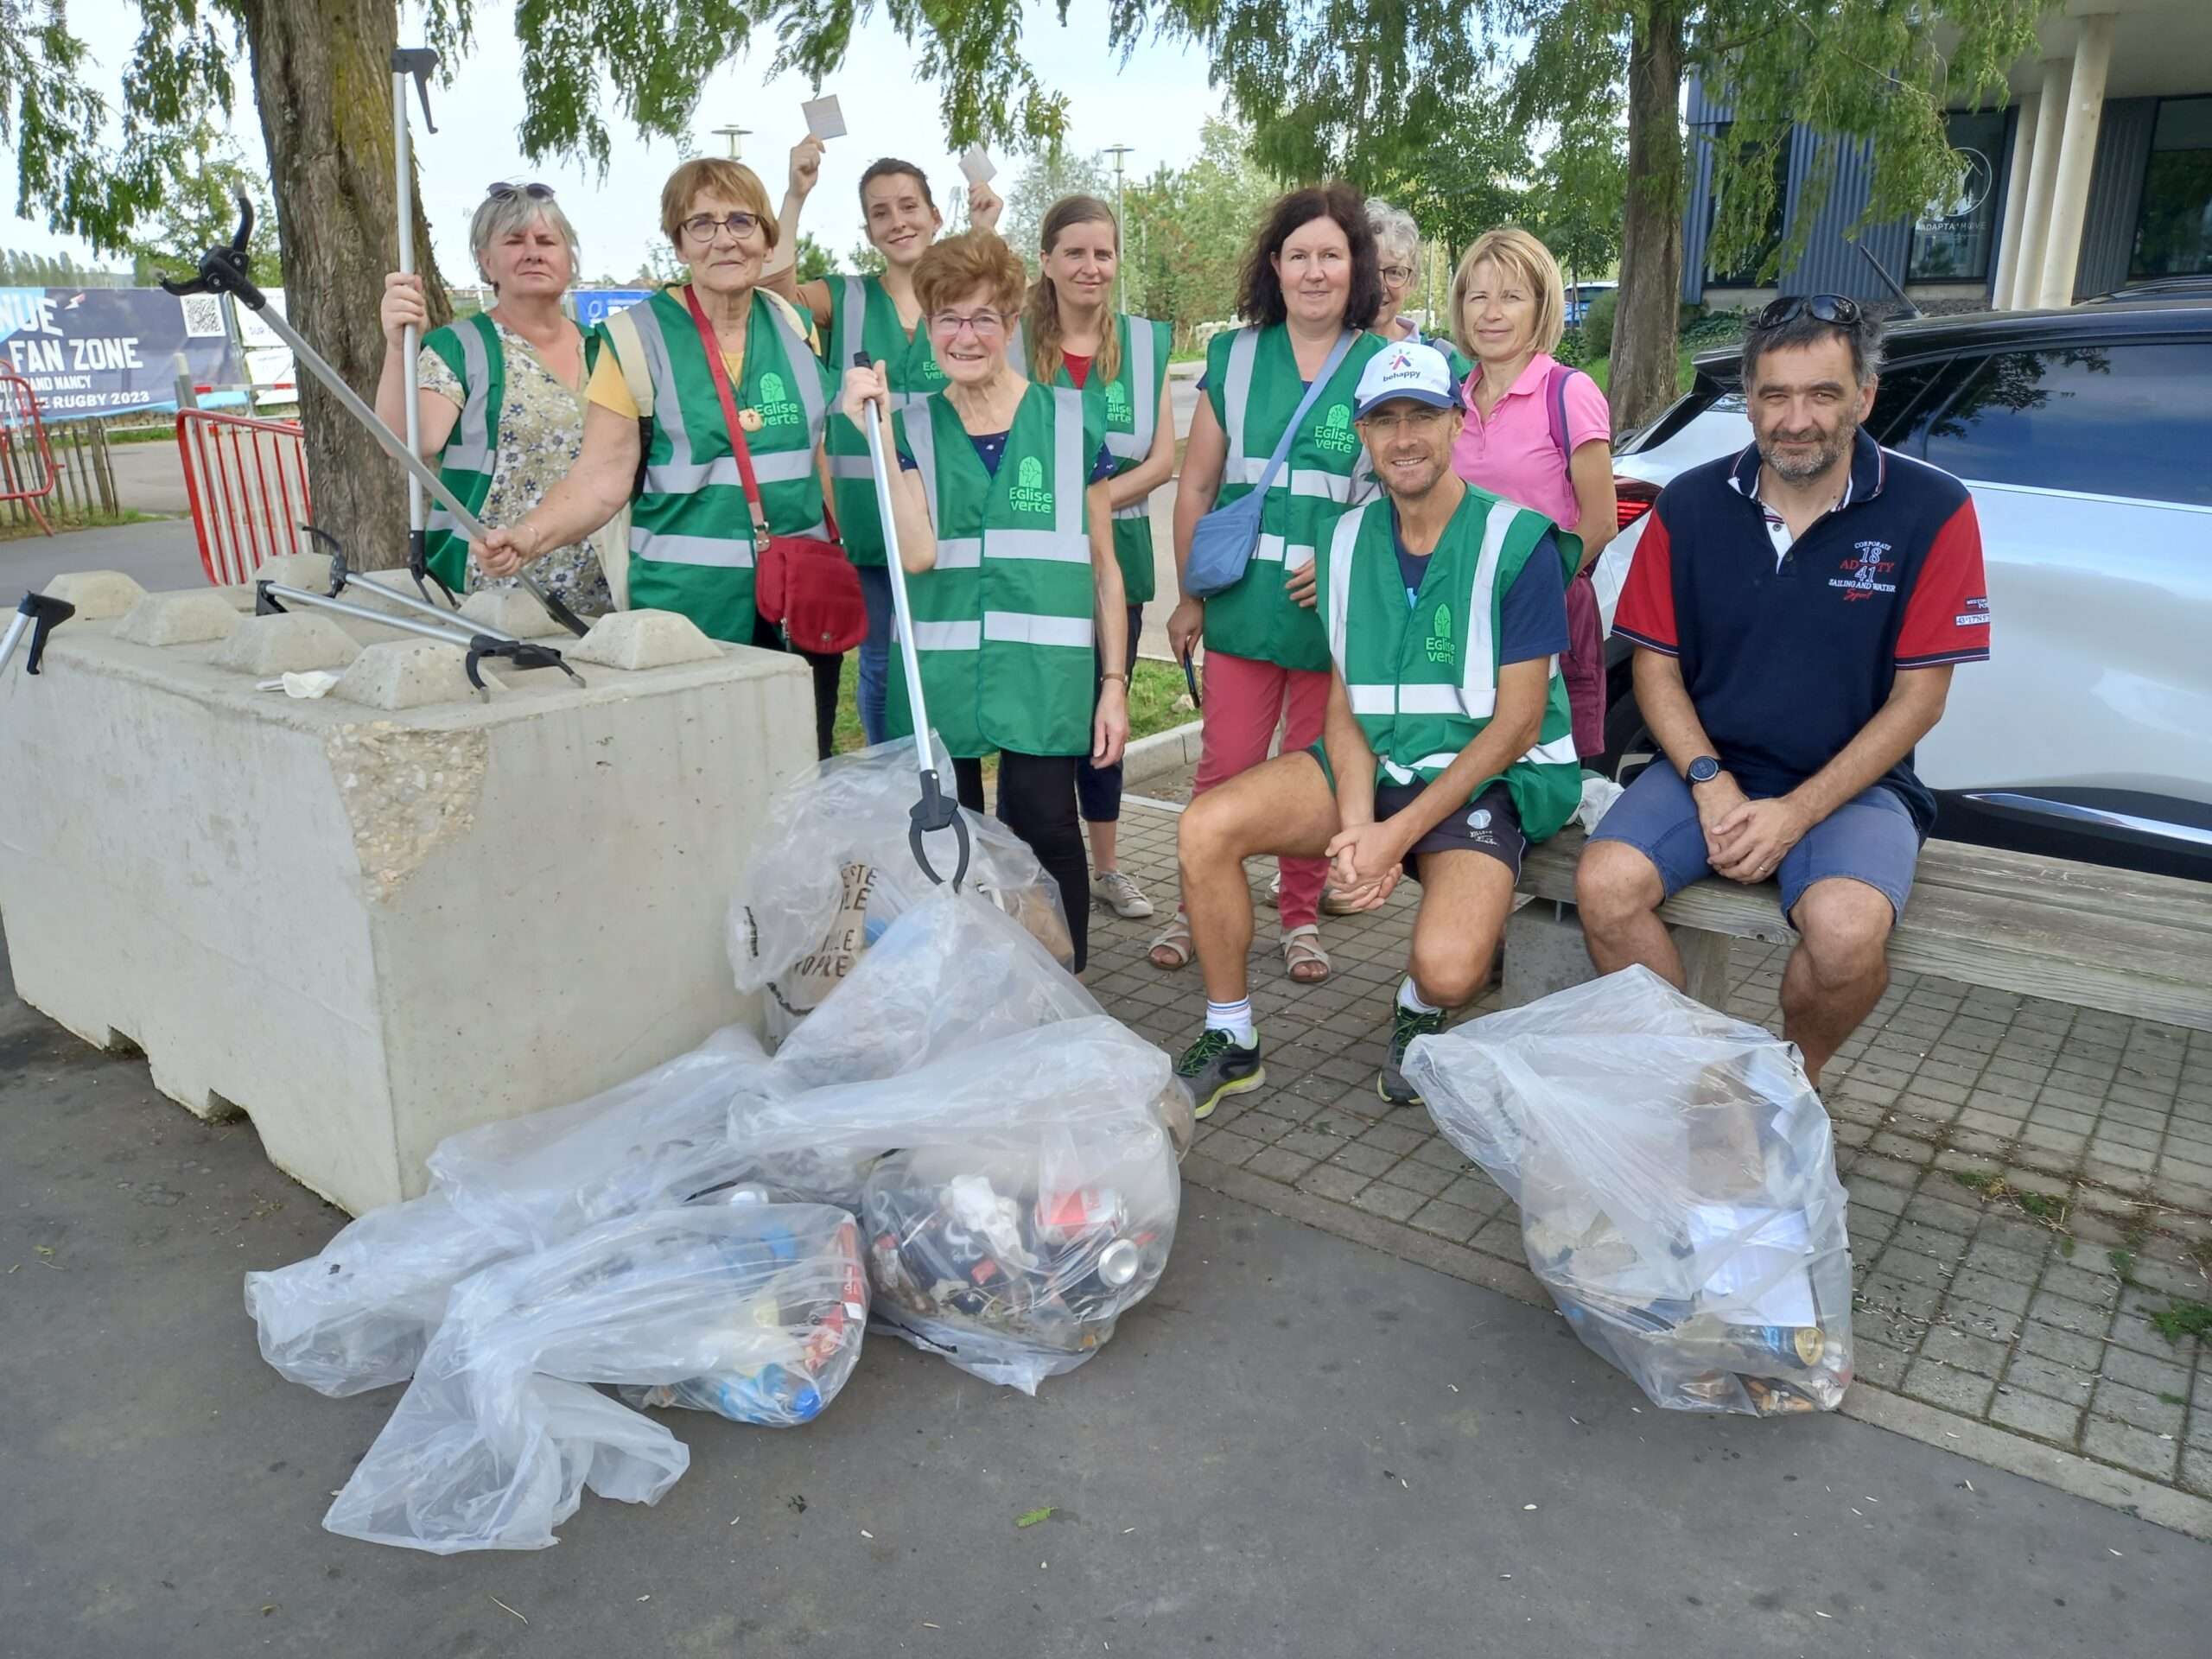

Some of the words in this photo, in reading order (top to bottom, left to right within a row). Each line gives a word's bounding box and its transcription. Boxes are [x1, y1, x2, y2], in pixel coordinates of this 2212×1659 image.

[8, 339, 66, 373] FAN
[68, 337, 144, 371] ZONE
[54, 374, 92, 388] NANCY
[1382, 371, 1421, 382] behappy
[53, 393, 106, 409] RUGBY
[110, 391, 149, 405] 2023
[1107, 413, 1131, 423] erte
[1315, 438, 1352, 454] verte
[1011, 500, 1052, 513] verte
[1859, 546, 1882, 564] 18
[1854, 565, 1876, 583] 41
[1828, 578, 1856, 588] SAILING
[1855, 581, 1872, 589] AND
[1872, 582, 1896, 593] WATER
